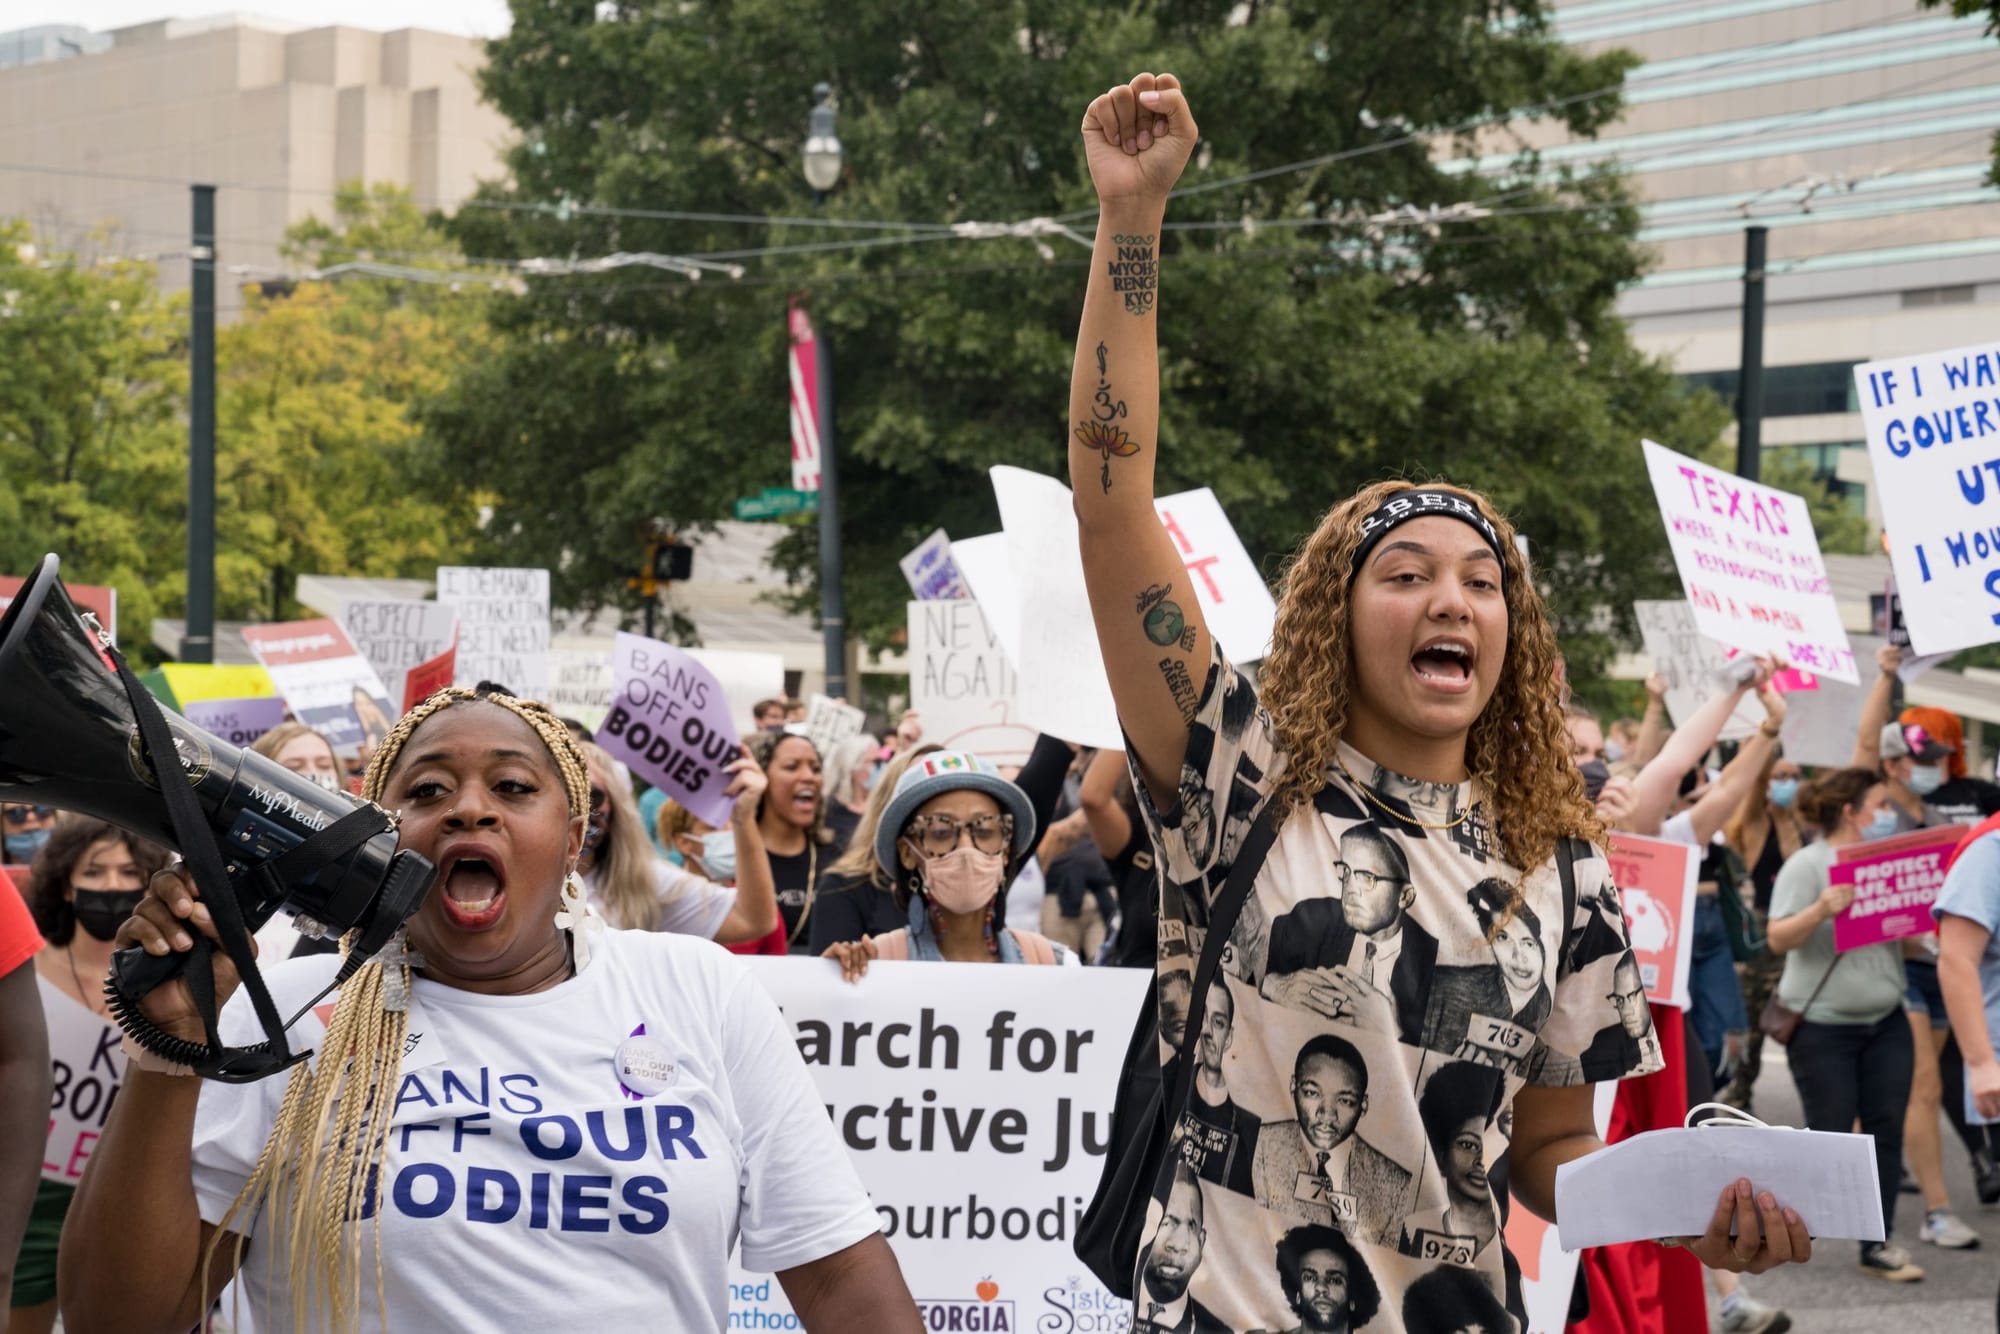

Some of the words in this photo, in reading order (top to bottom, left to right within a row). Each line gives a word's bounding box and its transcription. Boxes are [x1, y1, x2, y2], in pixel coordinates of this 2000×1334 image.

[1118, 247, 1153, 261] NAM
[1125, 291, 1154, 307] KYO
[1869, 370, 1898, 408] IF
[1911, 366, 1922, 397] I
[1678, 466, 1789, 536] TEXAS
[1914, 544, 1932, 583] I
[460, 654, 526, 684] AGINA
[631, 649, 710, 711] BANS
[201, 713, 239, 730] ANS
[627, 678, 684, 726] OFF
[605, 705, 711, 793] BODIES
[1854, 852, 1941, 884] PROTECT
[1854, 879, 1894, 901] AFE,
[1896, 870, 1945, 892] LEGA
[795, 1008, 960, 1069] arch
[986, 1010, 1094, 1074] for
[624, 1066, 668, 1081] BODIES
[649, 1061, 675, 1073] OUR
[392, 1066, 543, 1117] ANS
[519, 1104, 708, 1162] OUR
[842, 1089, 1028, 1154] ctive
[875, 1194, 1083, 1242] ourbodi
[729, 1279, 769, 1301] ned
[728, 1306, 805, 1331] nthoo
